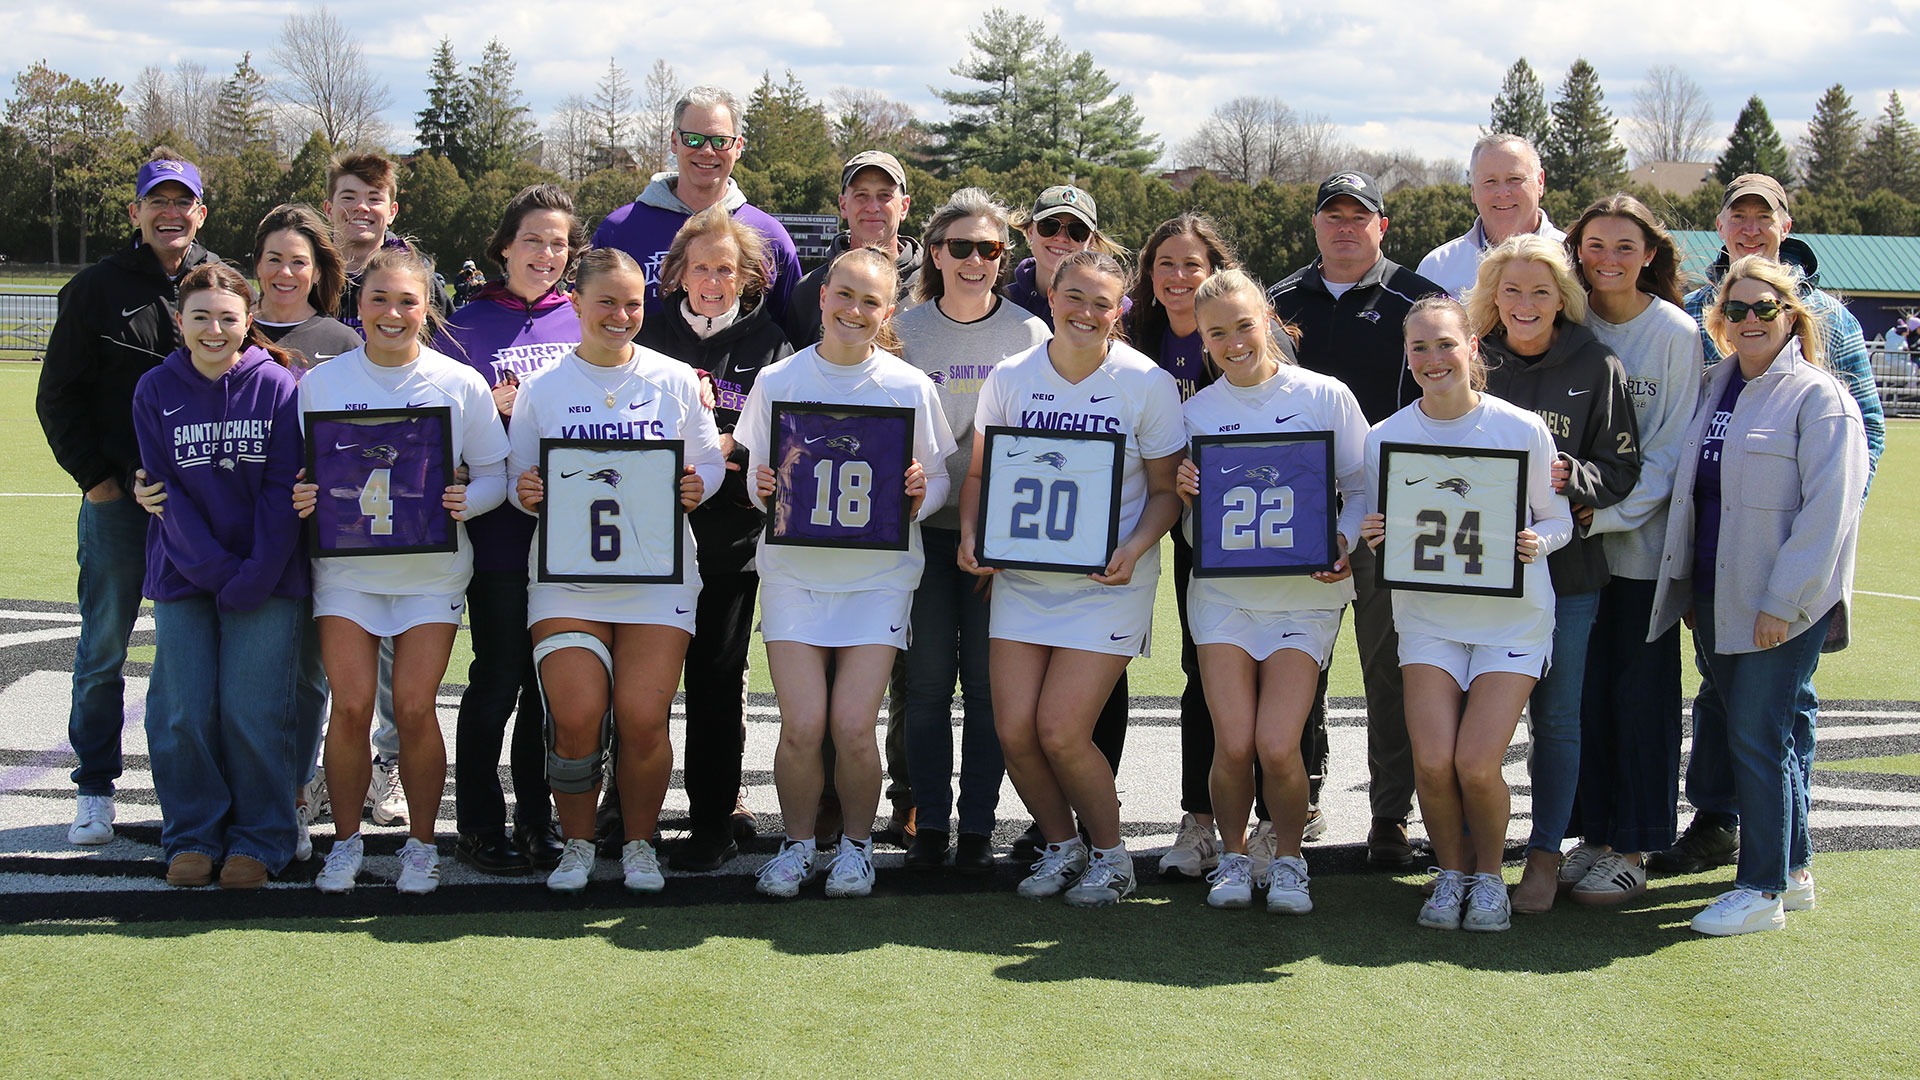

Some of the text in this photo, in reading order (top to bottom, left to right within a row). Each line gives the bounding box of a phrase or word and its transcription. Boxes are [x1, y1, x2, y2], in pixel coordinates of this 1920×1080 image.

[949, 365, 975, 379] SAINT
[562, 420, 666, 440] KNIGHTS
[1021, 410, 1120, 434] KNIGHTS
[358, 468, 394, 536] 4
[810, 459, 874, 528] 18
[1010, 477, 1081, 542] 20
[1221, 485, 1295, 551] 22
[589, 499, 622, 562] 6
[1413, 509, 1484, 576] 24
